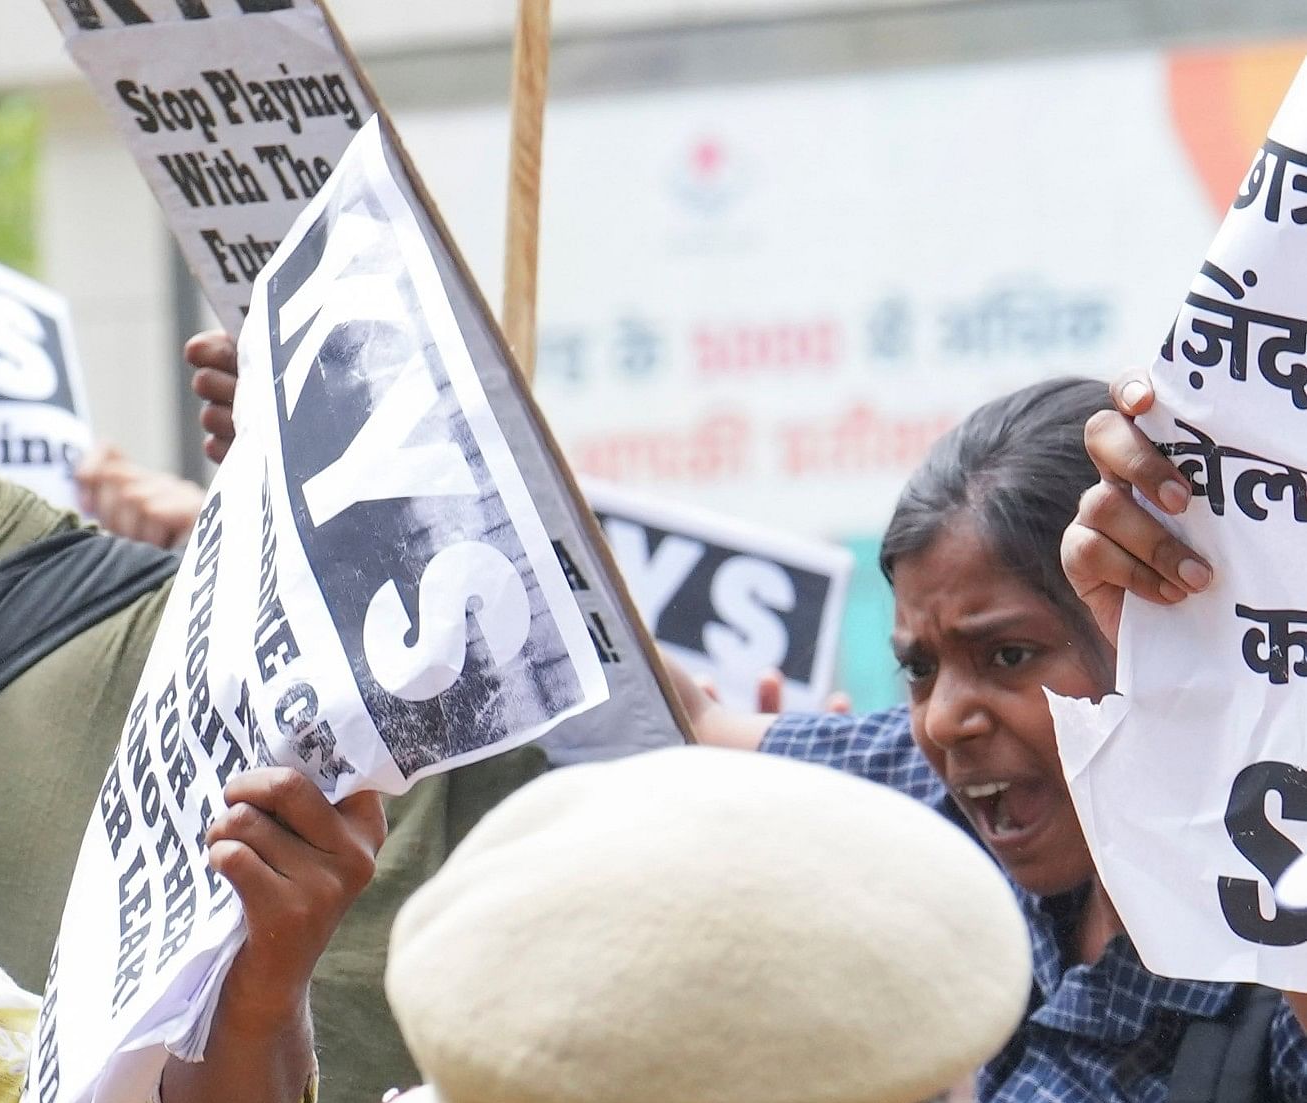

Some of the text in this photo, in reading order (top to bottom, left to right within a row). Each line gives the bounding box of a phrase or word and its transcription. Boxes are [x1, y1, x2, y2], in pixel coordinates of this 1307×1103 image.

[115, 63, 365, 143] Stop Playing
[157, 144, 334, 208] With The
[276, 200, 531, 703] KYS
[185, 490, 253, 790] AUTHORIT
[254, 455, 302, 685] SHAME
[607, 516, 798, 675] YS
[156, 671, 197, 811] FOR
[127, 691, 197, 976] ANOTHER
[112, 843, 152, 1021] LEAK!
